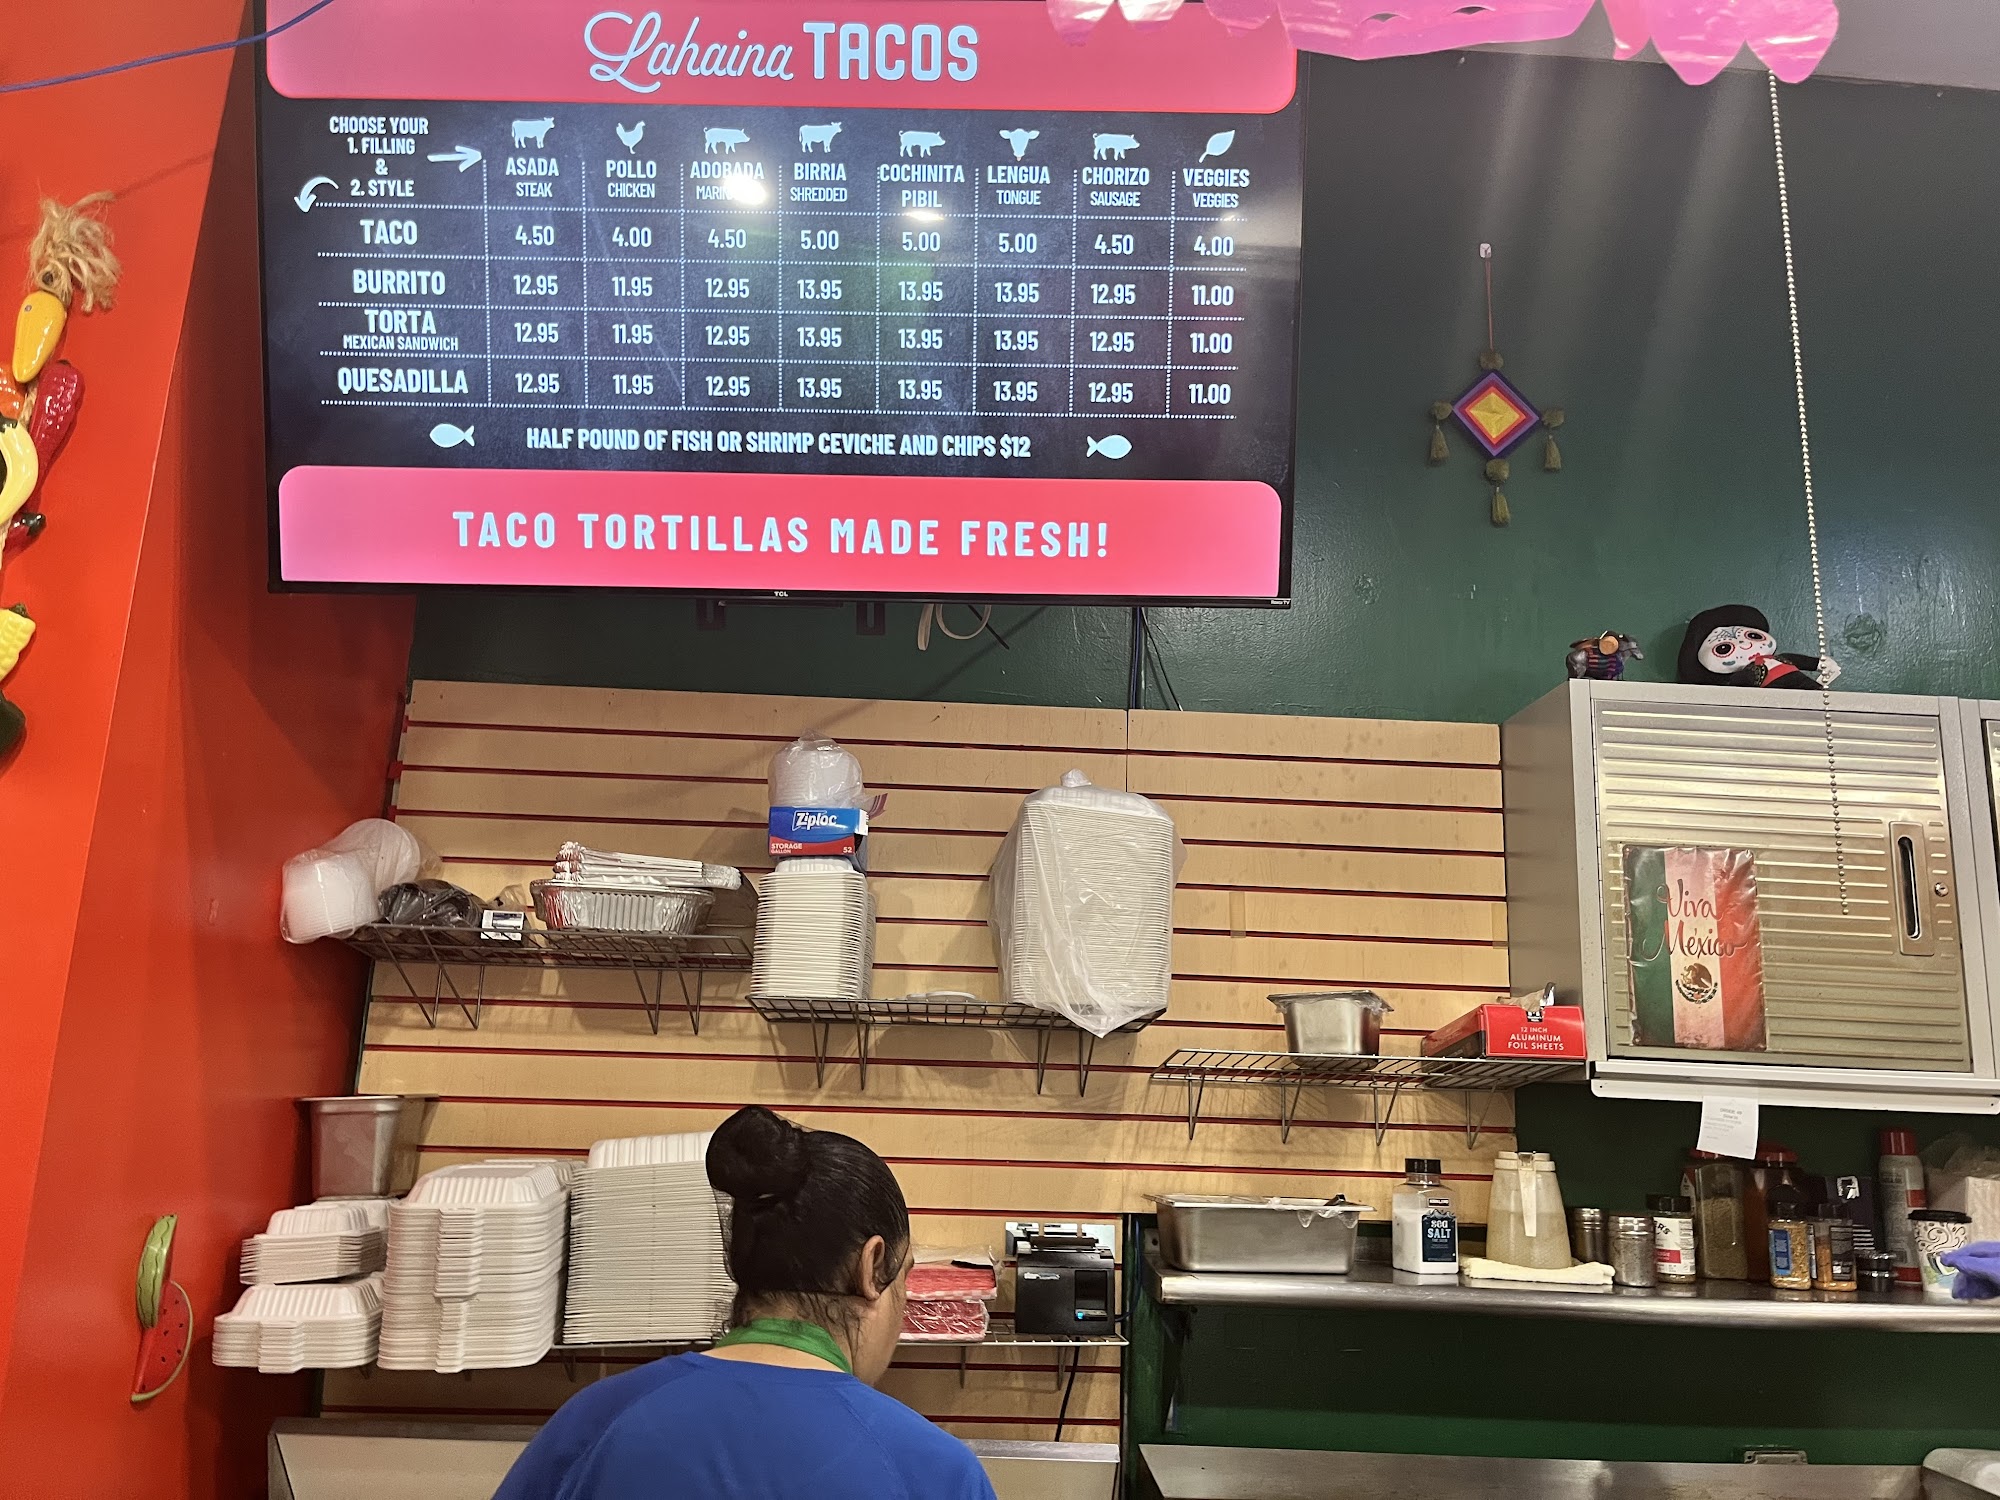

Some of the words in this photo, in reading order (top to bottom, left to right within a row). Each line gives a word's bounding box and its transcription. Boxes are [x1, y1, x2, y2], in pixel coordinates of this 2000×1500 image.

[584, 12, 793, 93] Lahaina
[803, 22, 977, 81] TACOS
[330, 116, 386, 134] CHOOSE
[390, 117, 428, 134] YOUR
[347, 137, 358, 153] 1.
[362, 137, 415, 154] FILLING
[375, 158, 388, 175] &
[506, 158, 559, 176] ASADA
[606, 160, 656, 178] POLLO
[689, 160, 765, 180] ADOBADA
[794, 163, 846, 180] BIRRIA
[879, 164, 965, 182] COCHINITA
[988, 165, 1050, 184] LENGUA
[1083, 167, 1149, 185] CHORIZO
[351, 179, 365, 196] 2.
[368, 179, 414, 196] STYLE
[1183, 168, 1249, 187] VEGGIES
[516, 182, 552, 197] STEAK
[608, 183, 655, 198] CHICKEN
[790, 187, 847, 201] SHREDDED
[901, 190, 942, 208] PIBIL
[996, 190, 1041, 205] TONGUE
[1090, 191, 1140, 206] SAUSAGE
[1193, 193, 1239, 208] VEGGIES
[360, 220, 417, 244] TACO
[516, 225, 554, 245] 4.50
[612, 227, 651, 247] 4.00
[708, 229, 746, 248] 4.50
[801, 230, 838, 250] 5.00
[903, 232, 940, 251] 5.00
[999, 233, 1037, 253] 5.00
[1095, 234, 1133, 254] 4.50
[1193, 235, 1234, 257] 4.00
[353, 269, 445, 295] BURRITO
[514, 275, 558, 295] 12.95
[612, 277, 652, 296] 11.95
[705, 278, 749, 298] 12.95
[797, 280, 841, 299] 13.95
[898, 281, 943, 301] 13.95
[995, 282, 1039, 302] 13.95
[1091, 284, 1135, 304] 12.95
[1192, 285, 1233, 305] 11.00
[364, 309, 436, 334] TORTA
[515, 323, 558, 342] 12.95
[613, 324, 653, 344] 11.95
[706, 326, 749, 346] 12.95
[797, 327, 841, 347] 13.95
[898, 329, 942, 349] 13.95
[994, 330, 1038, 351] 13.95
[1090, 332, 1134, 352] 12.95
[343, 335, 394, 349] MEXICAN
[397, 336, 458, 351] SANDWICH
[1190, 333, 1232, 353] 11.00
[338, 367, 468, 394] QUESADILLA
[515, 373, 559, 393] 12.95
[613, 375, 653, 394] 11.95
[706, 376, 750, 396] 12.95
[797, 378, 842, 398] 13.95
[898, 379, 942, 400] 13.95
[993, 381, 1037, 401] 13.95
[1089, 382, 1133, 403] 12.95
[1189, 384, 1231, 404] 11.00
[527, 428, 574, 449] HALF
[578, 429, 639, 450] POUND
[644, 430, 668, 450] OF
[672, 430, 712, 451] FISH
[717, 431, 742, 452] OR
[746, 432, 814, 453] SHRIMP
[819, 433, 896, 455] CEVICHE
[900, 435, 937, 455] AND
[943, 435, 996, 456] CHIPS
[1000, 434, 1030, 458] $12
[453, 512, 555, 548] TACO
[578, 514, 807, 552] TORTILLAS
[831, 518, 938, 555] MADE
[962, 521, 1106, 557] FRESH!
[796, 812, 837, 830] Ziploc
[1657, 879, 1723, 921] Viva
[1643, 919, 1747, 961] México
[1508, 1041, 1528, 1050] FOIL
[1531, 1042, 1564, 1051] SHEETS
[1510, 1033, 1561, 1042] ALUMINUM
[1427, 1228, 1451, 1239] SALT
